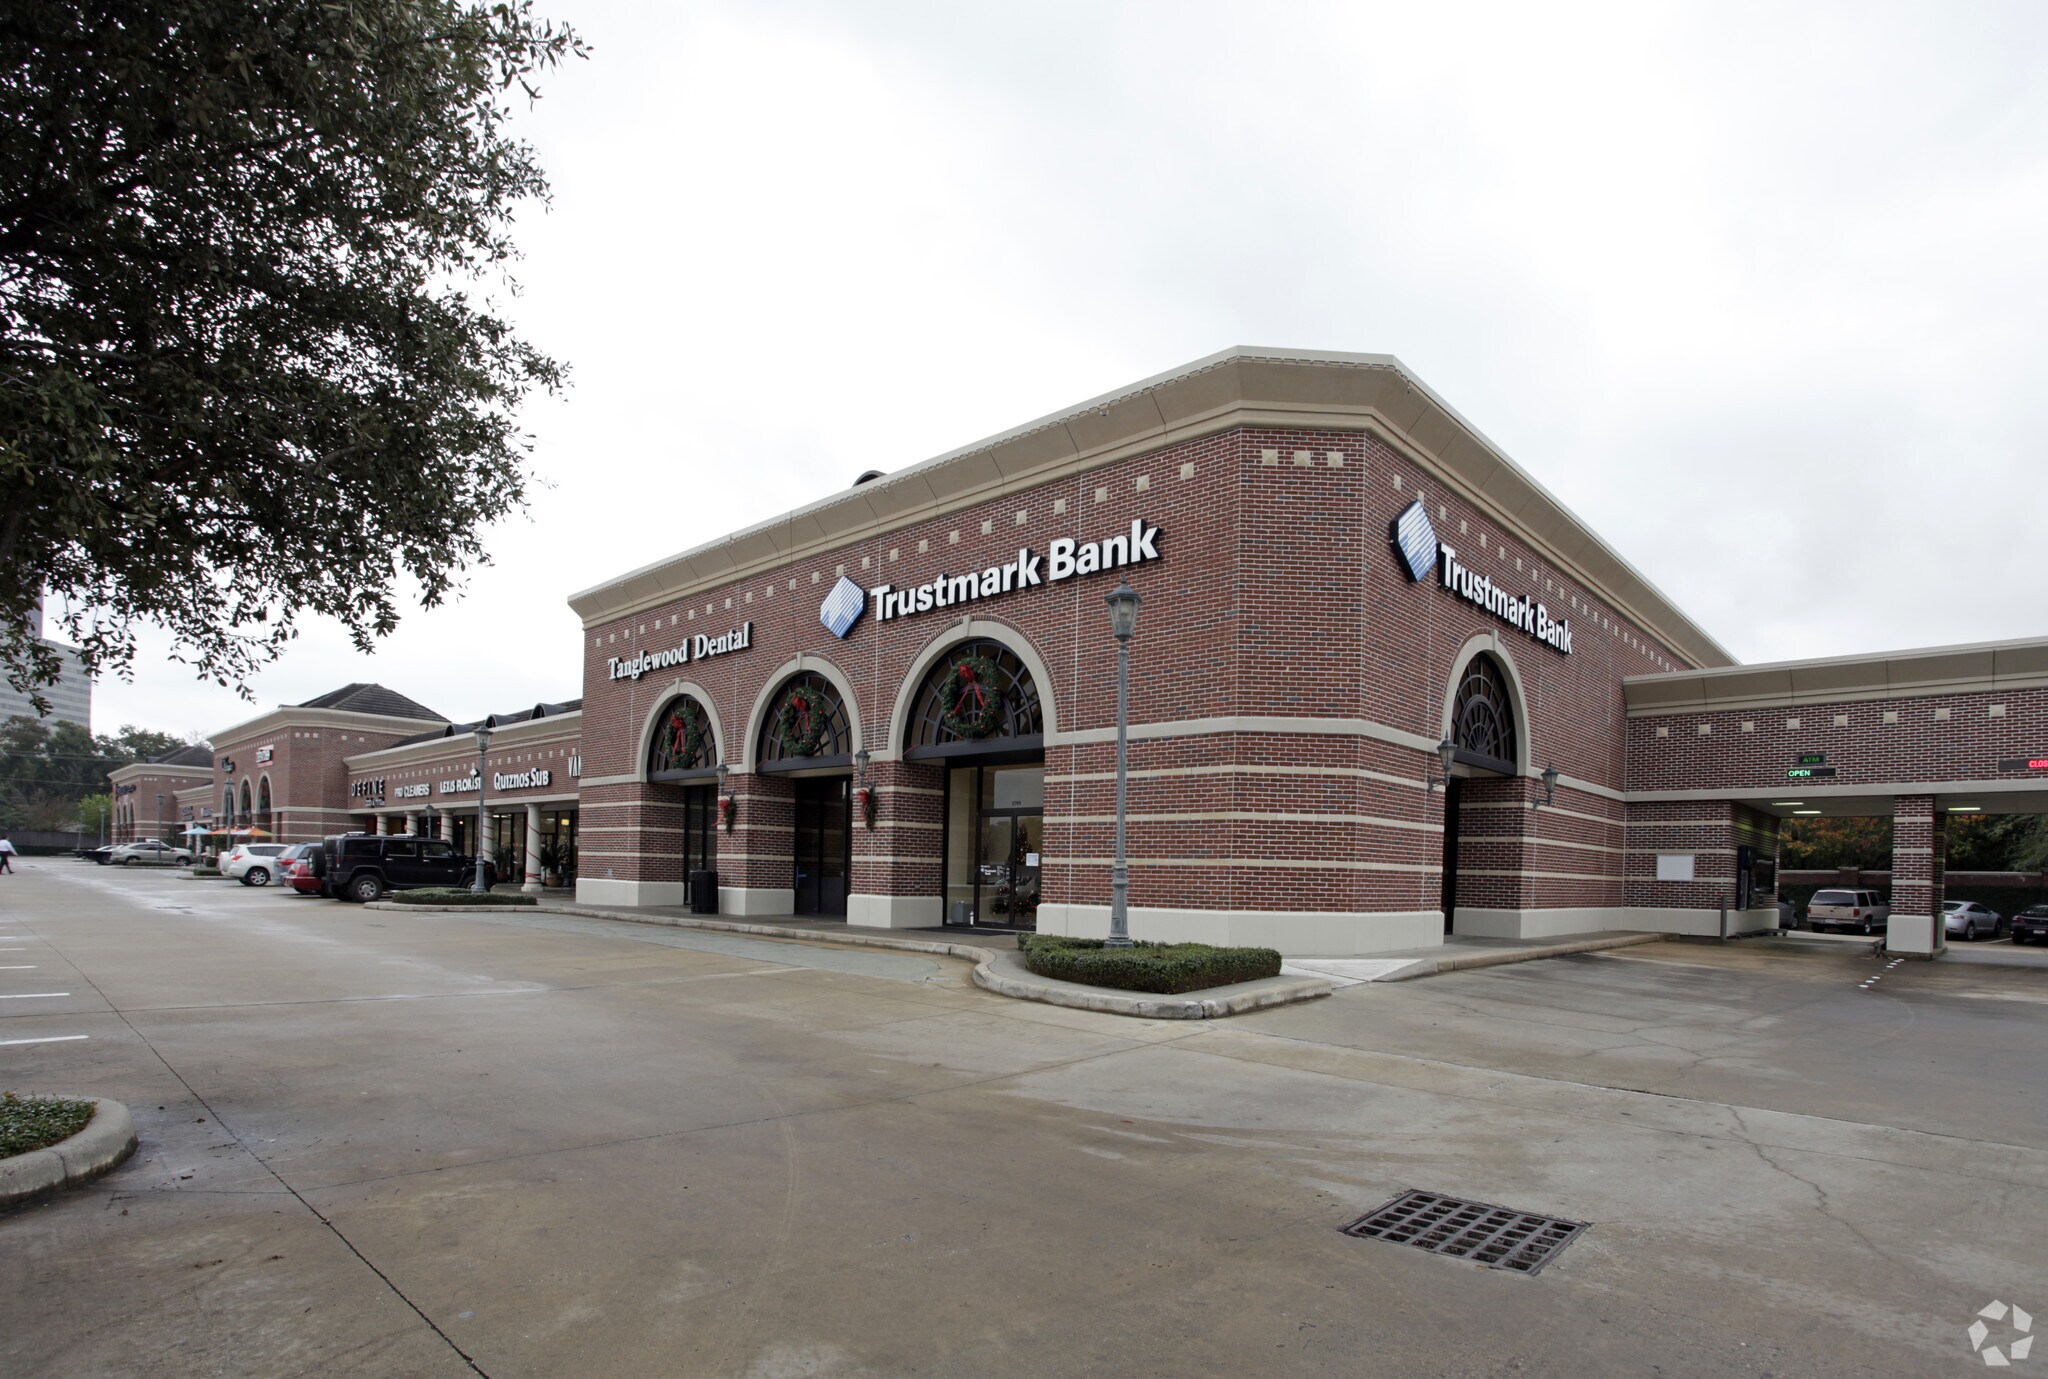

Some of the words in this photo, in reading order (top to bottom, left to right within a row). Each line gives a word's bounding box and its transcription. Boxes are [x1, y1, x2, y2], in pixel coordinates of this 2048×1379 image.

[871, 548, 1042, 621] Trustmark
[1049, 519, 1160, 581] Bank
[1440, 542, 1535, 634] Trustmark
[1536, 603, 1573, 655] Bank
[607, 637, 688, 680] Tanglewood
[694, 621, 752, 659] Dental
[1788, 769, 1811, 777] OPEN
[2028, 760, 2048, 768] CLOS
[351, 779, 384, 797] DEFINE
[404, 783, 431, 798] CLEANERS
[439, 780, 456, 794] LEXIS
[456, 771, 482, 792] FLORIST
